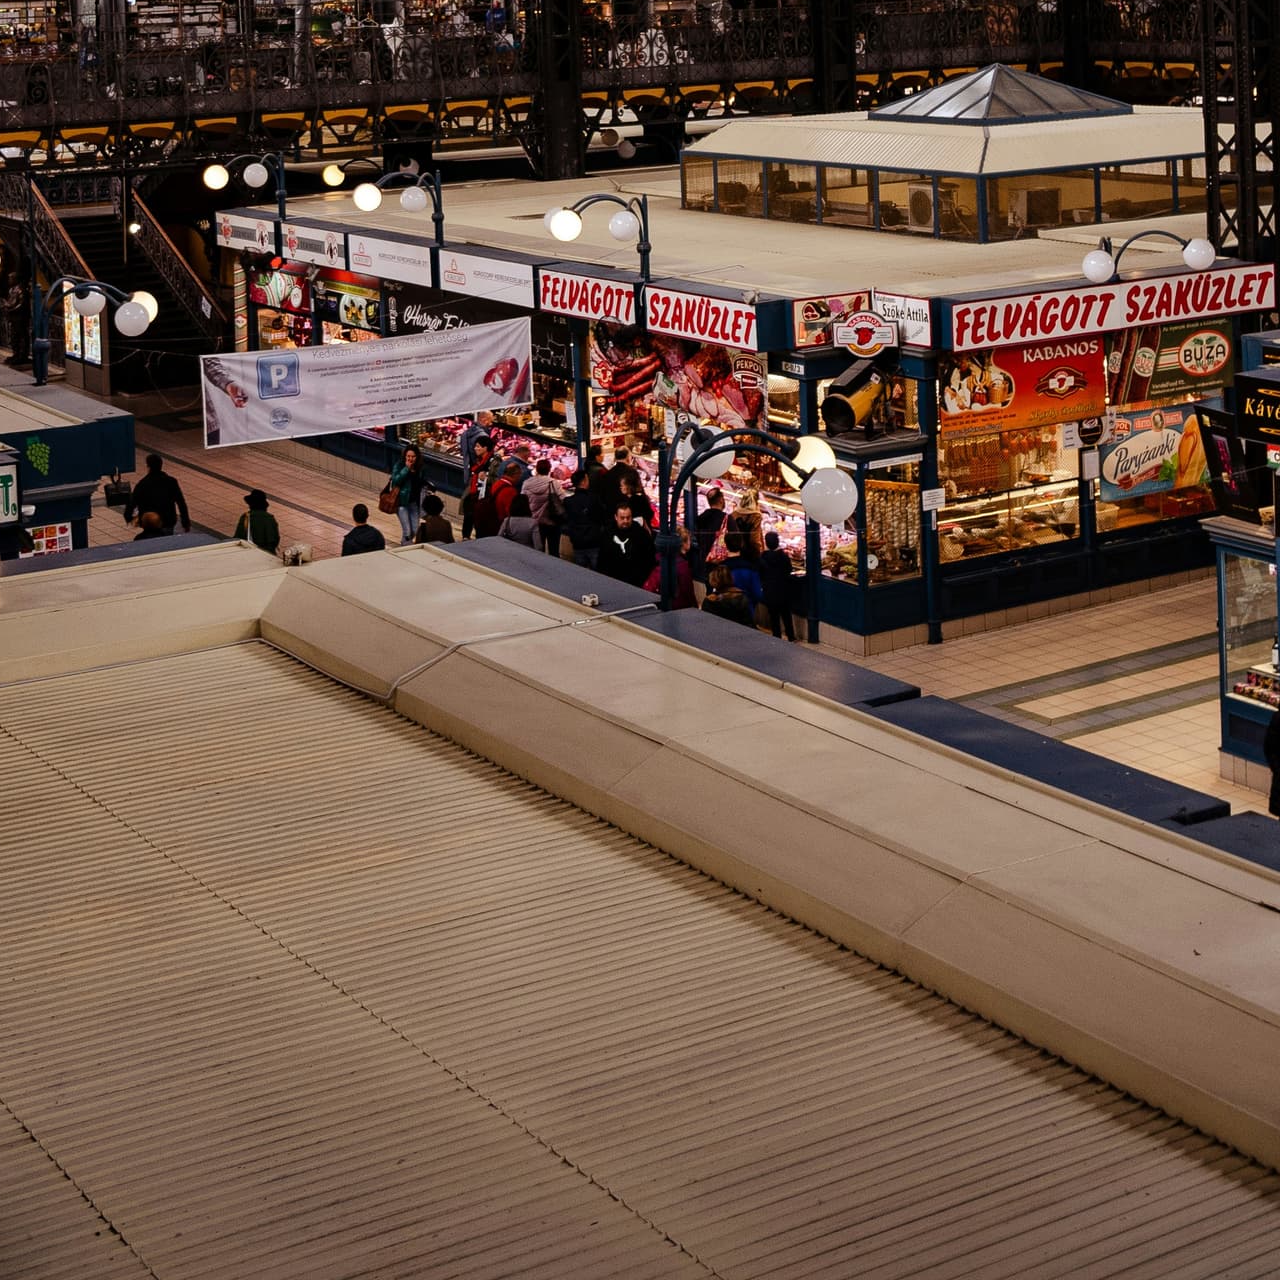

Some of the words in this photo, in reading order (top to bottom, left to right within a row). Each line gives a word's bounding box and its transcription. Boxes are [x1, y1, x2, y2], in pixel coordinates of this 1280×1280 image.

[541, 274, 635, 320] FELVÁGOTT
[882, 303, 905, 320] Szőke
[907, 307, 929, 323] Attila
[955, 292, 1116, 346] FELVÁGOTT
[1126, 271, 1273, 323] SZAKÜZLET
[649, 293, 757, 344] SZAKÜZLET
[1023, 340, 1100, 363] KABANOS
[1183, 344, 1226, 363] BUZA
